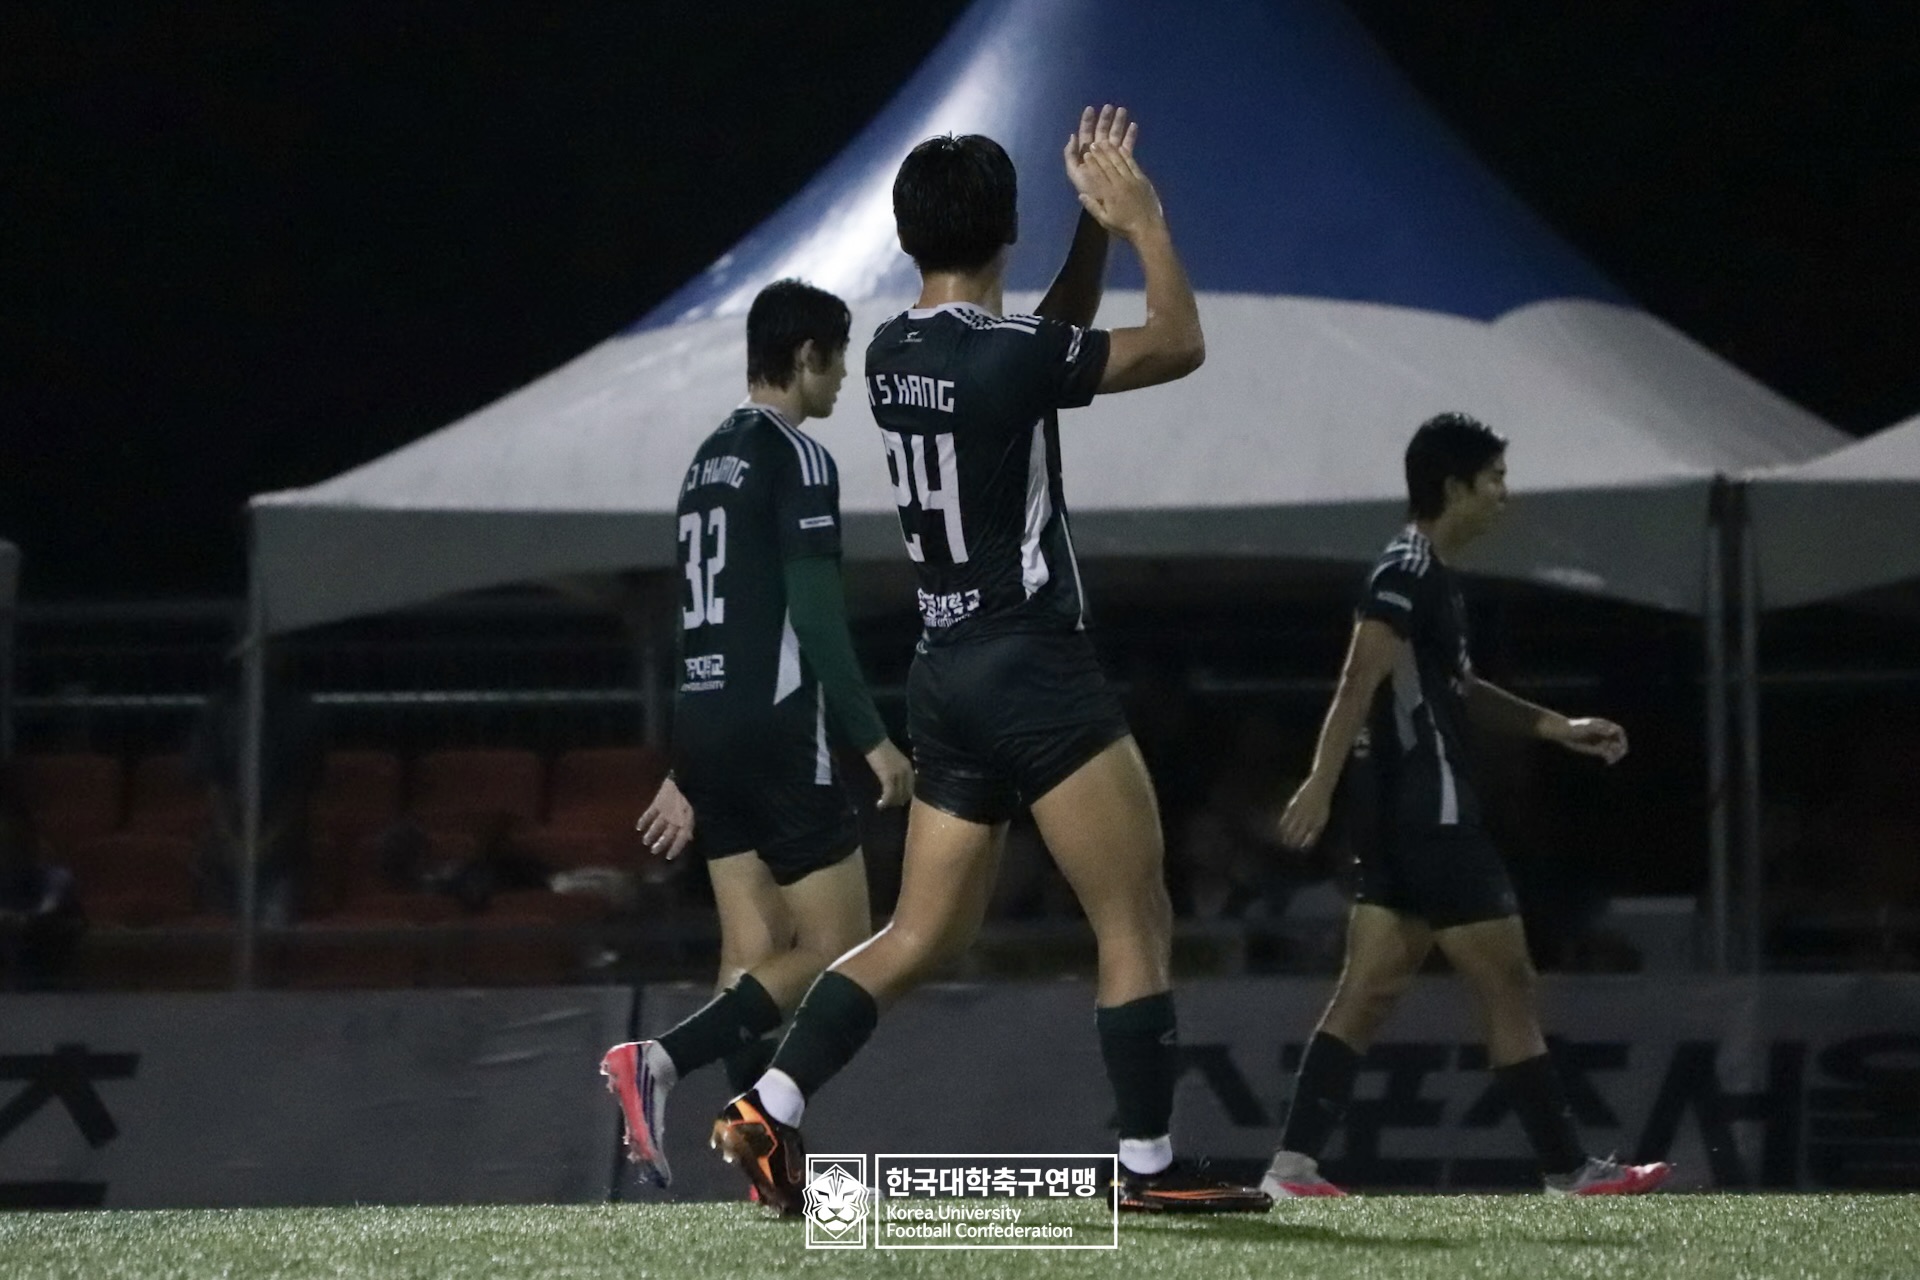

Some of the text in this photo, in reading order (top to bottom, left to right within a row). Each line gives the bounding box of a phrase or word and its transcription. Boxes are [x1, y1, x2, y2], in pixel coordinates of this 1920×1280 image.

[875, 373, 893, 405] S
[894, 373, 955, 413] KANG
[880, 431, 970, 564] 24
[678, 506, 727, 630] 32
